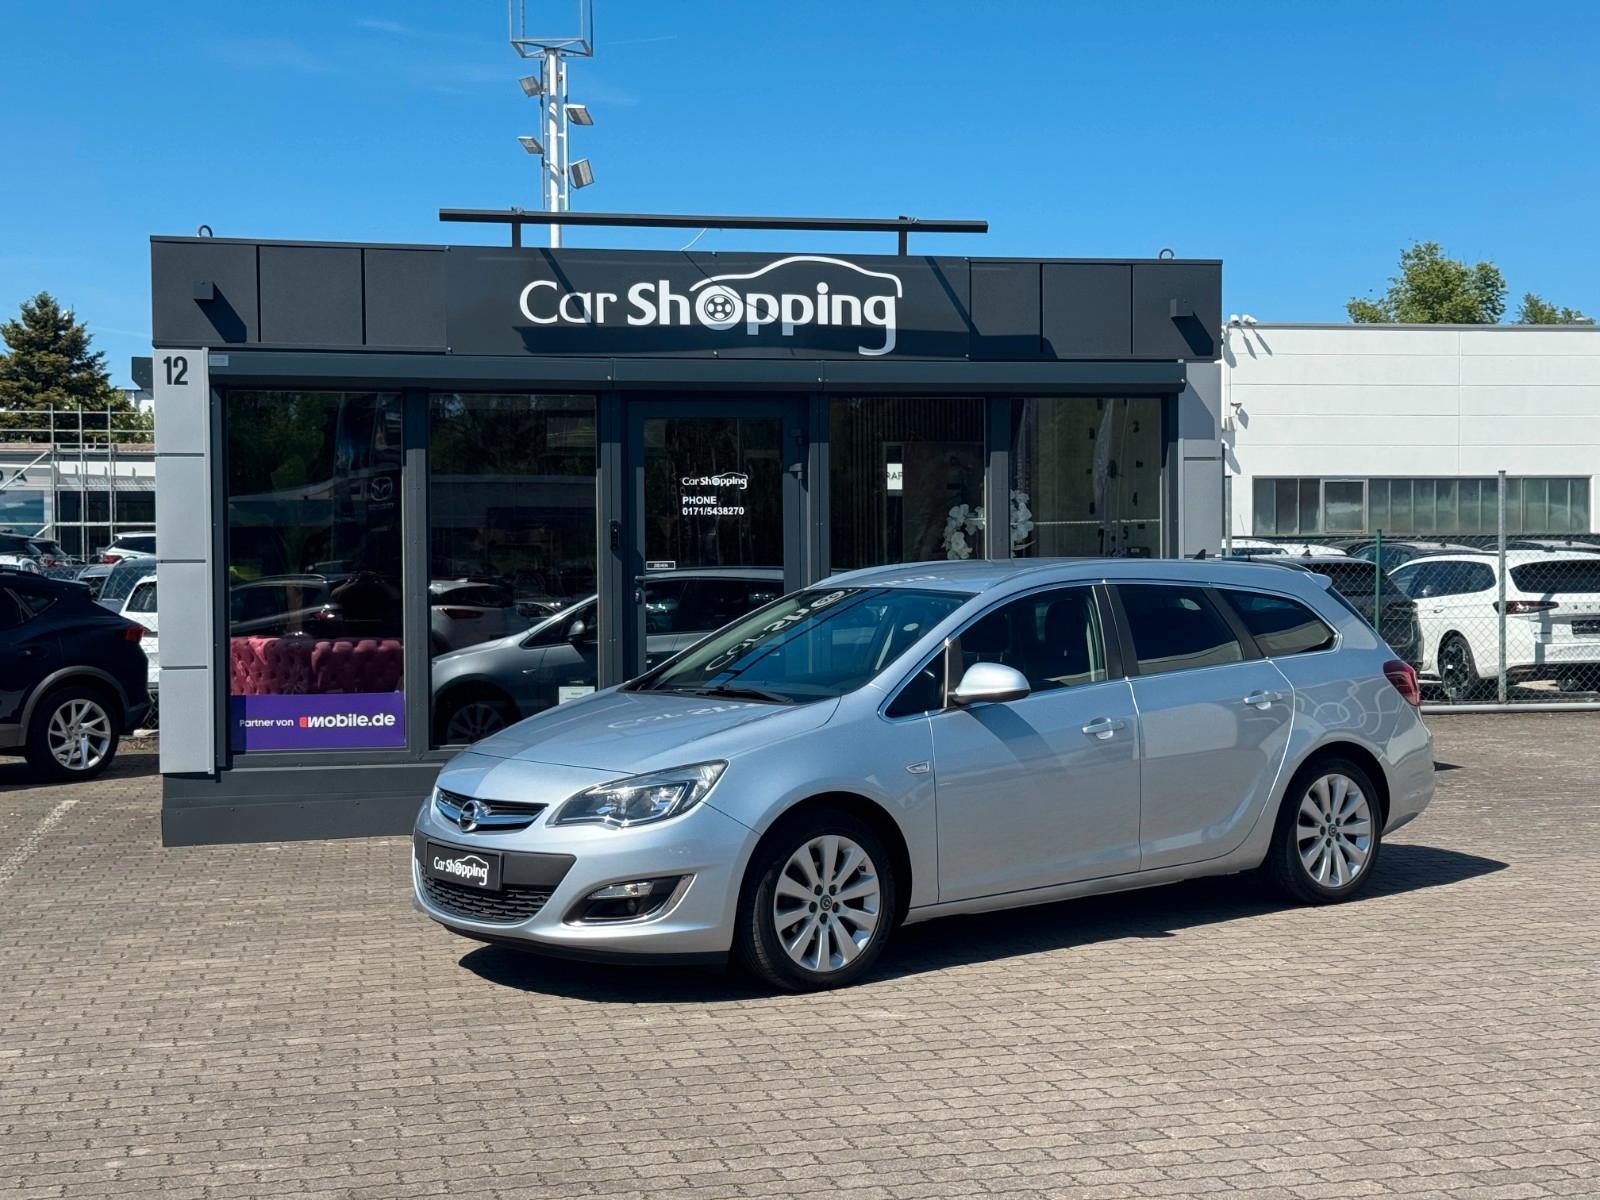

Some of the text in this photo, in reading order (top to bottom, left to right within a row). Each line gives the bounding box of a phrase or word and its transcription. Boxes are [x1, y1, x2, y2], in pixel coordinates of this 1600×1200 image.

[519, 279, 897, 356] Car Shopping
[163, 356, 188, 385] 12
[682, 476, 747, 489] Car Shopping
[682, 496, 717, 504] PHONE
[682, 507, 744, 515] 0171/5438270
[239, 713, 396, 728] Partner von mobile.de
[434, 857, 446, 871] Car
